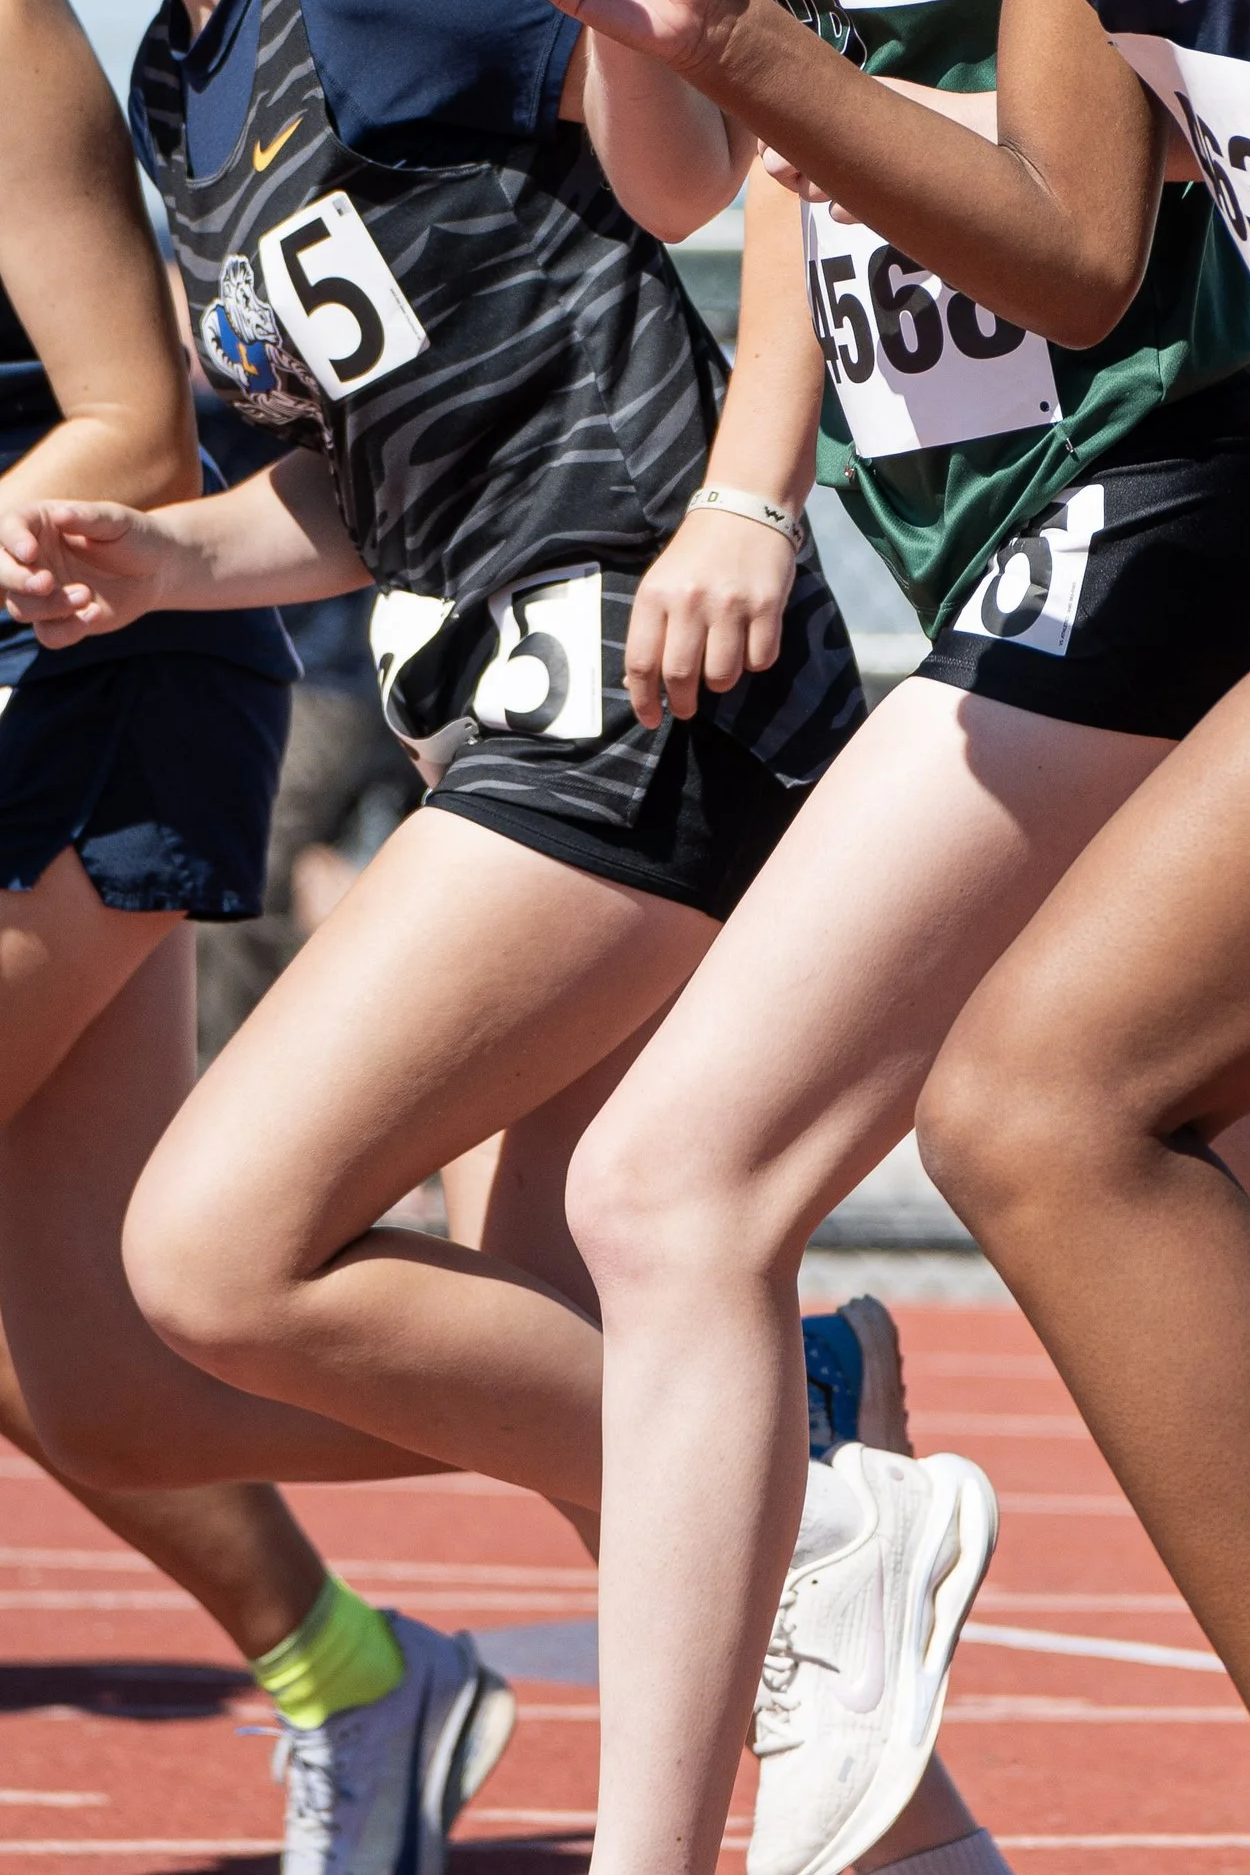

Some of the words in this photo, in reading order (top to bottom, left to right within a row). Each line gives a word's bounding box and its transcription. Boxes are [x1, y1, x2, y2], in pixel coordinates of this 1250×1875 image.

[279, 216, 386, 384] 5
[980, 501, 1069, 638] 6
[504, 578, 570, 733] 5
